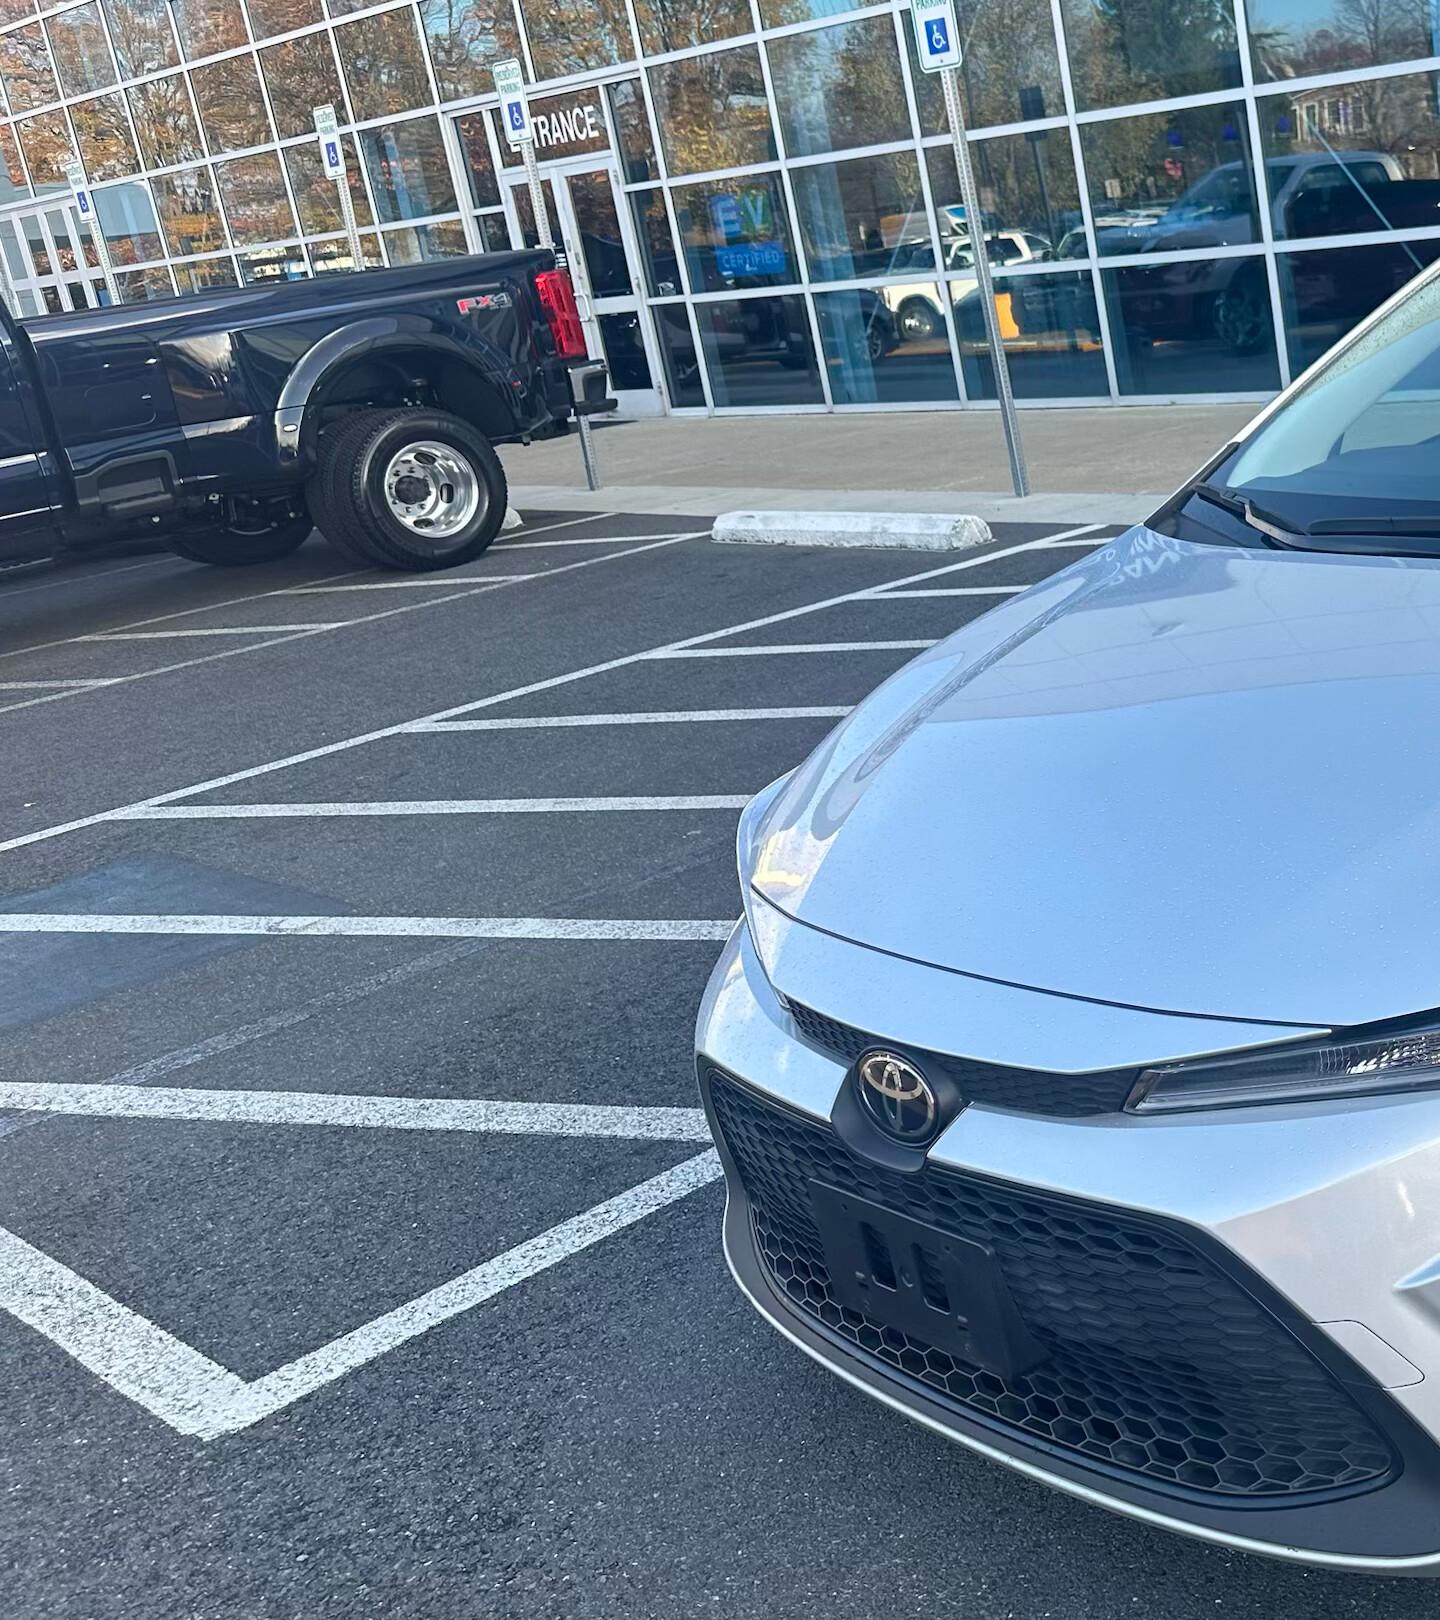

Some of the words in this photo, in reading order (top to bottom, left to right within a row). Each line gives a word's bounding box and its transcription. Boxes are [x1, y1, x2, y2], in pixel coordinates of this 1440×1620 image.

[511, 105, 600, 152] TRANCE
[716, 195, 765, 234] EV
[722, 249, 780, 269] CERTIFIED
[456, 292, 513, 315] FX4
